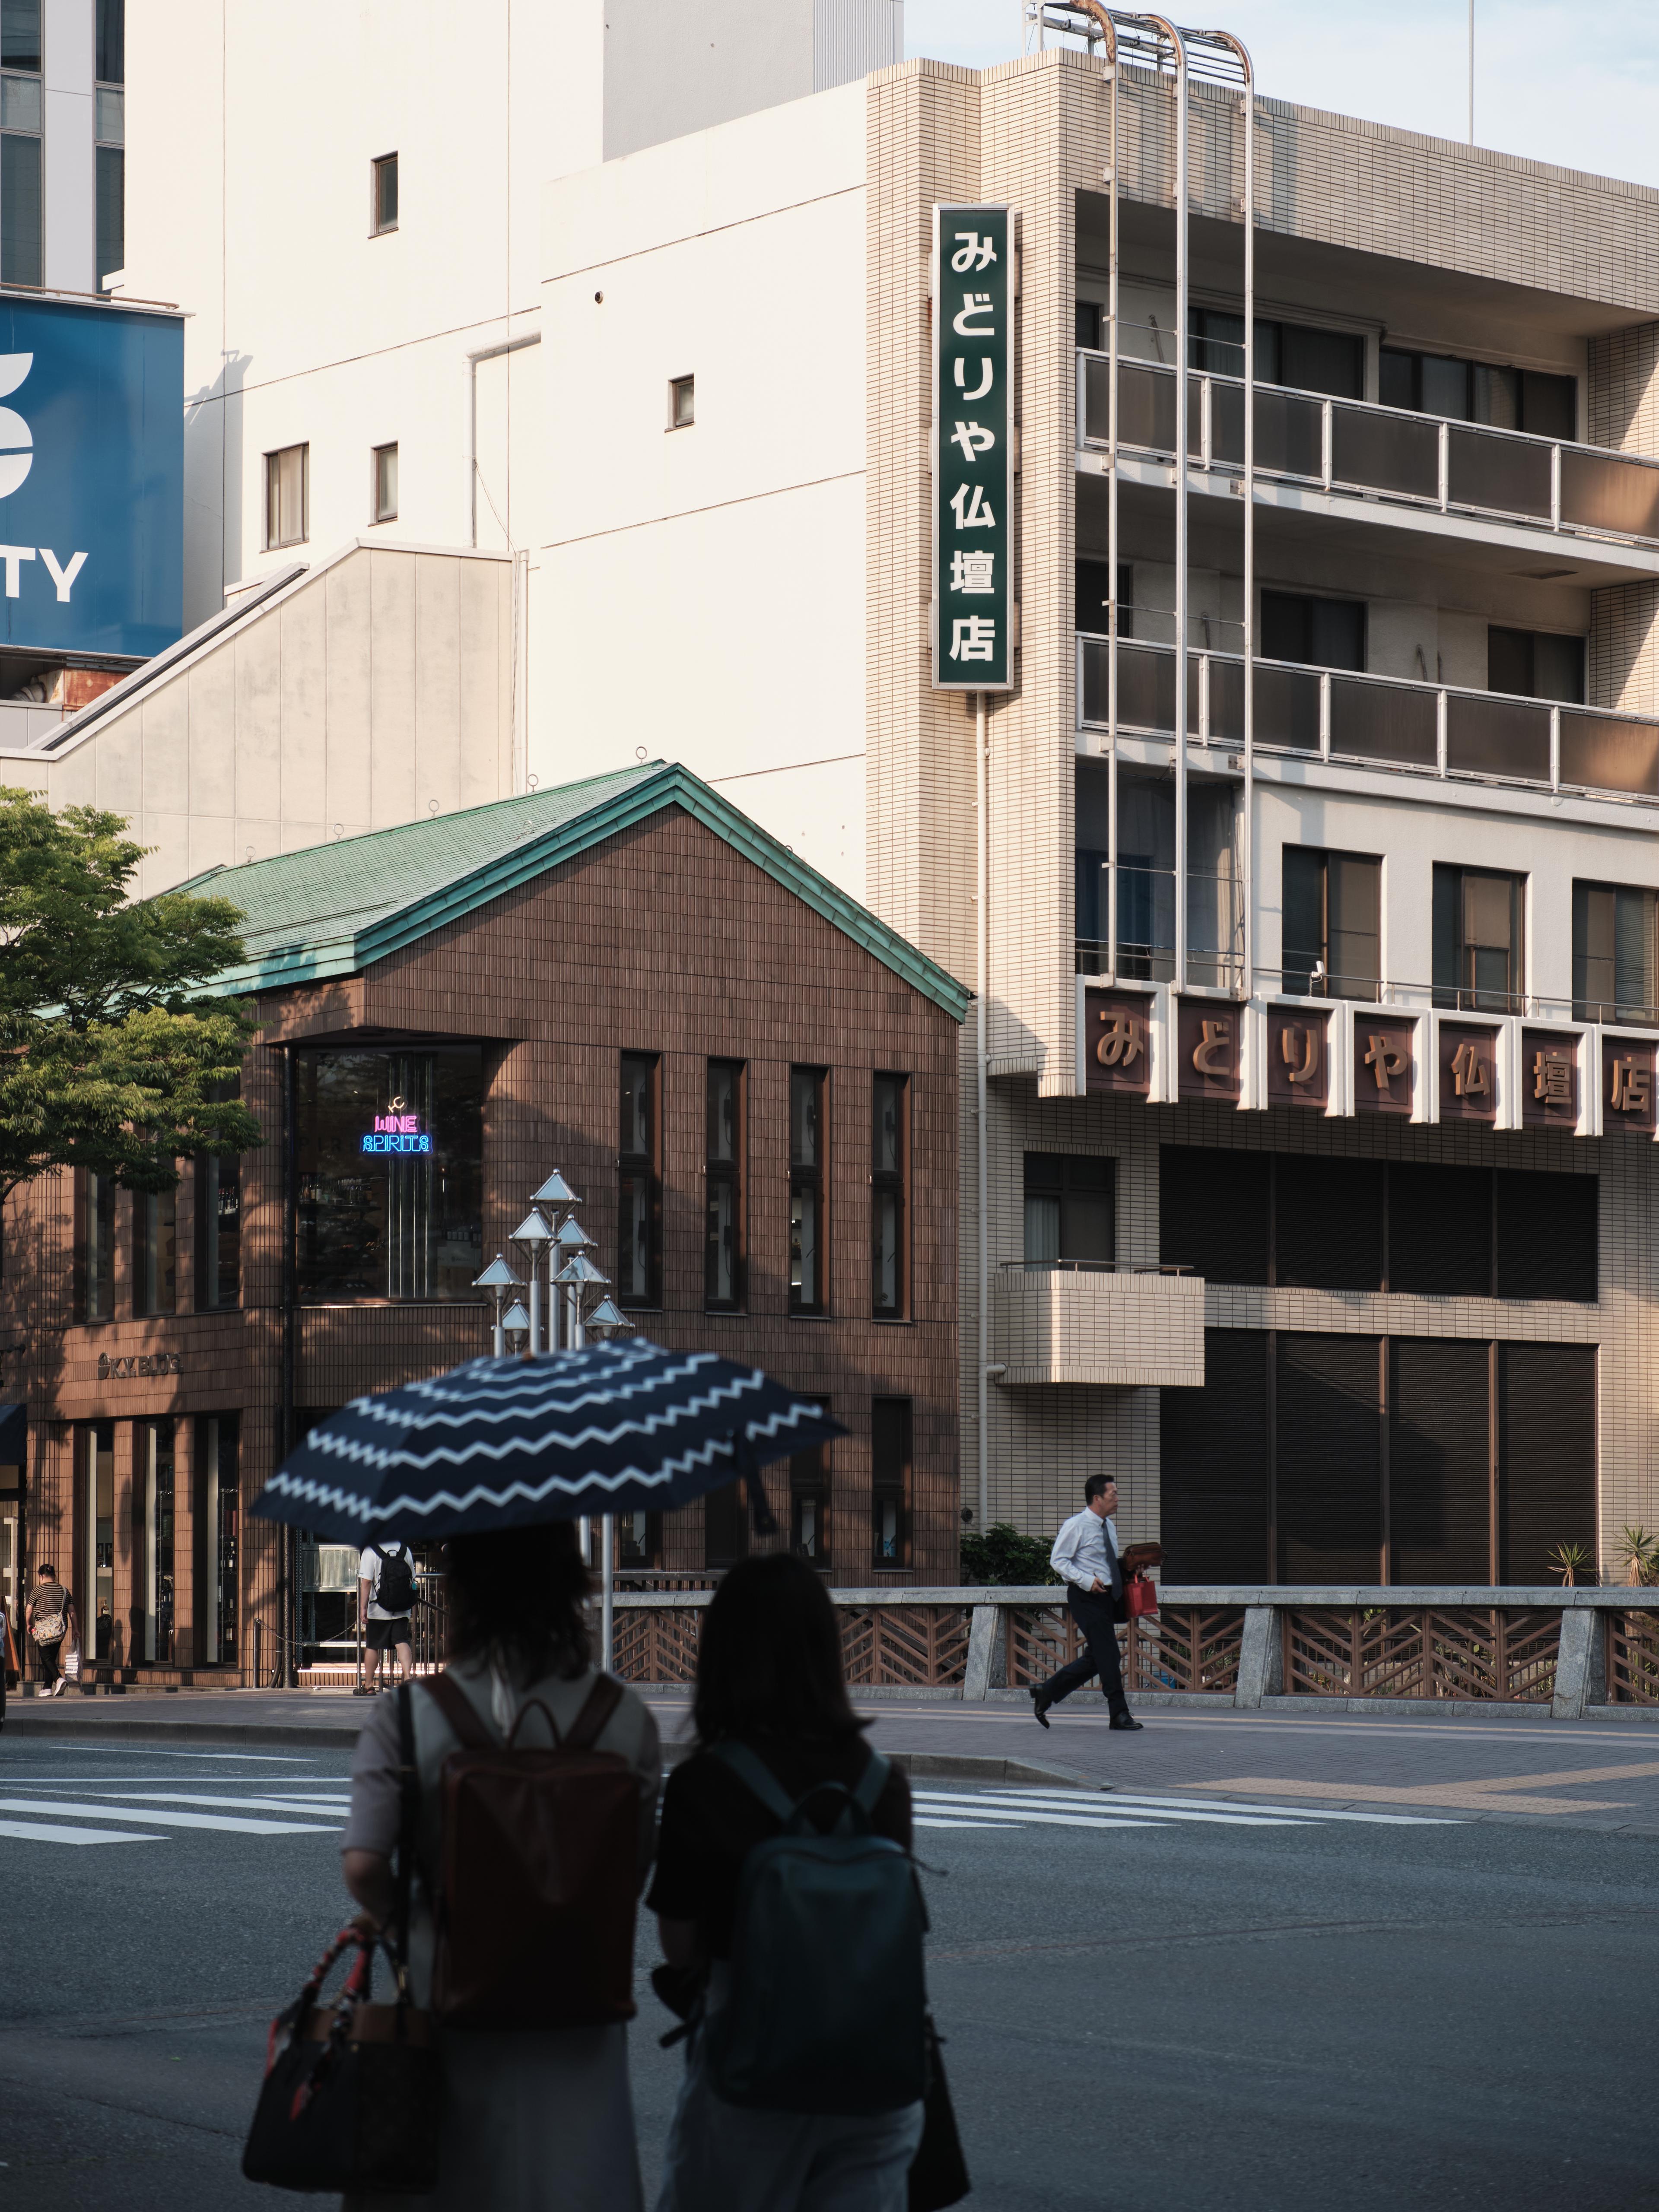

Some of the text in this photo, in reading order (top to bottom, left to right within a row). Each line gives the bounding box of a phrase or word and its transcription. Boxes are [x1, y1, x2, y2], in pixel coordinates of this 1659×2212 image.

[949, 232, 998, 662] みどりや仏壇店
[0, 545, 89, 602] TY
[1097, 1011, 1651, 1112] みどりや仏壇店
[362, 1135, 429, 1152] SPIRITS
[374, 1115, 418, 1133] WINE
